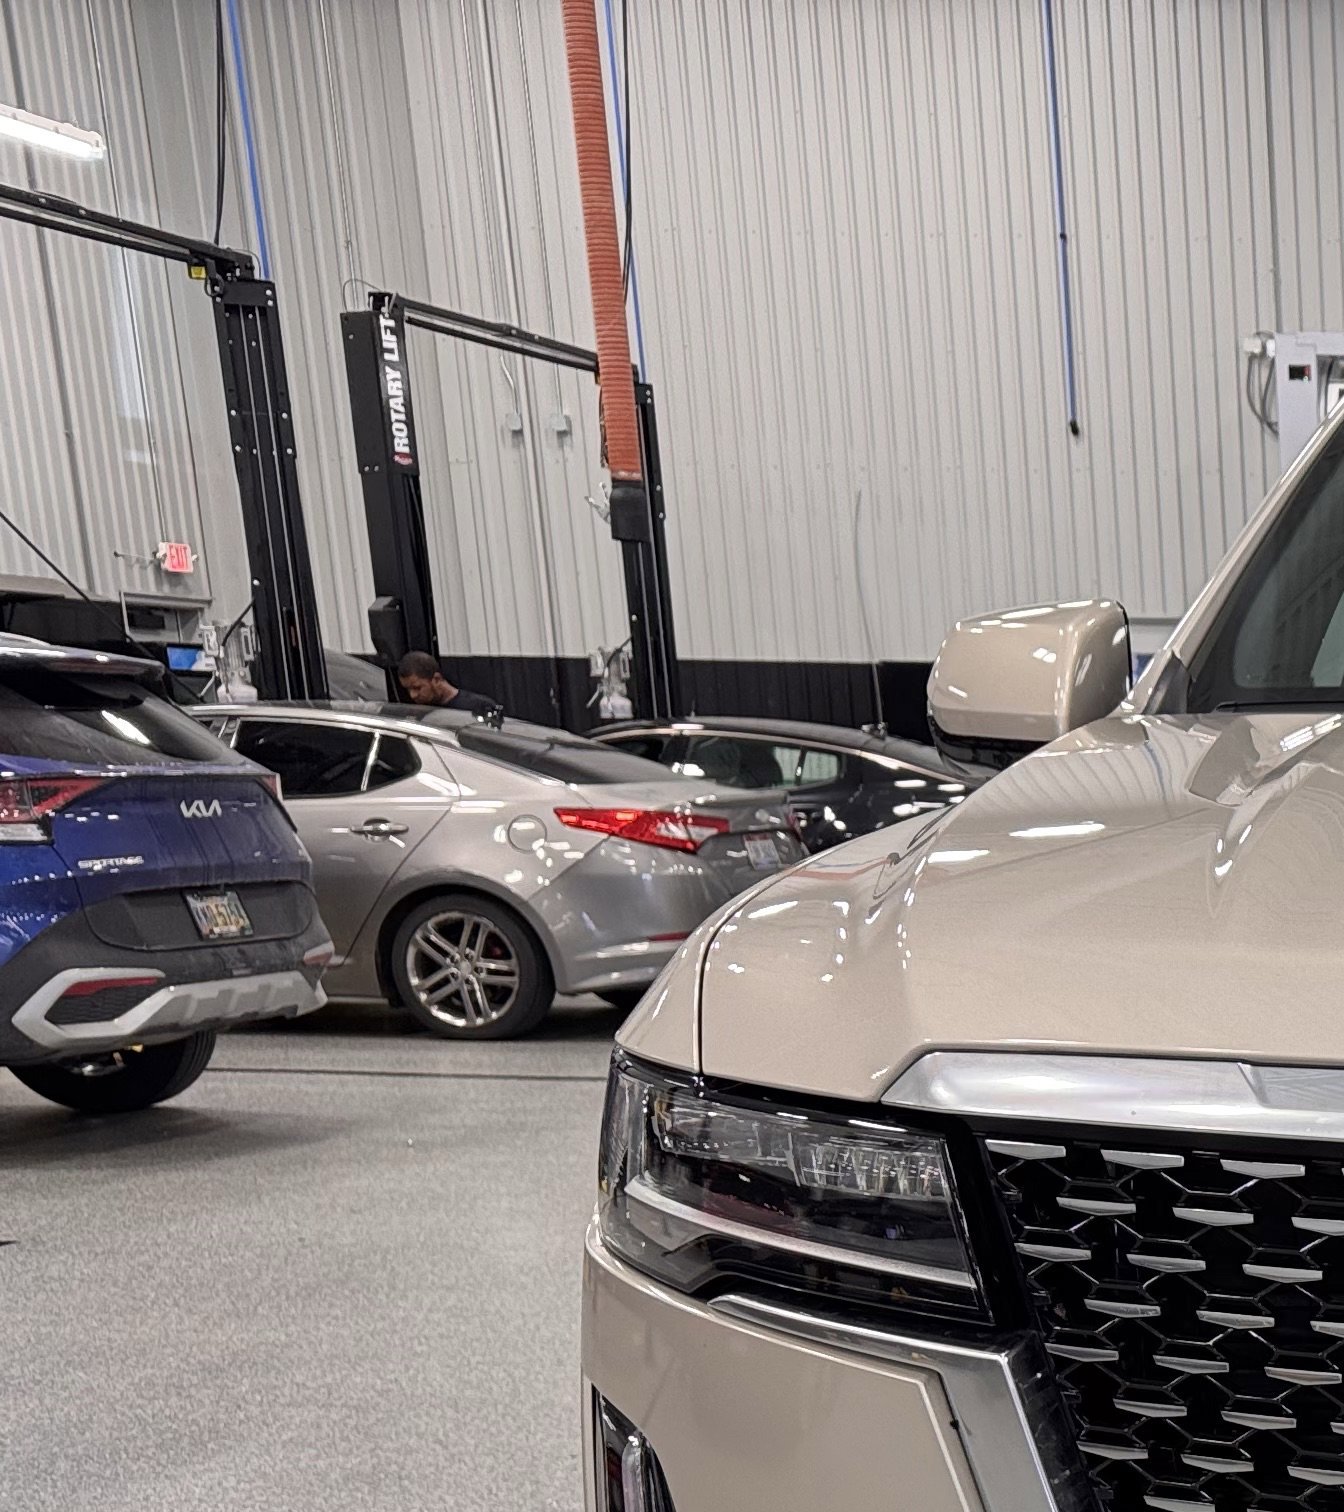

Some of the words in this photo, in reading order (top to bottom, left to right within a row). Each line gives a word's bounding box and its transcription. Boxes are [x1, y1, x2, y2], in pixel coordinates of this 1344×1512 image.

[379, 314, 400, 362] LIFT
[385, 365, 410, 453] ROTARY
[168, 544, 188, 569] EXIT
